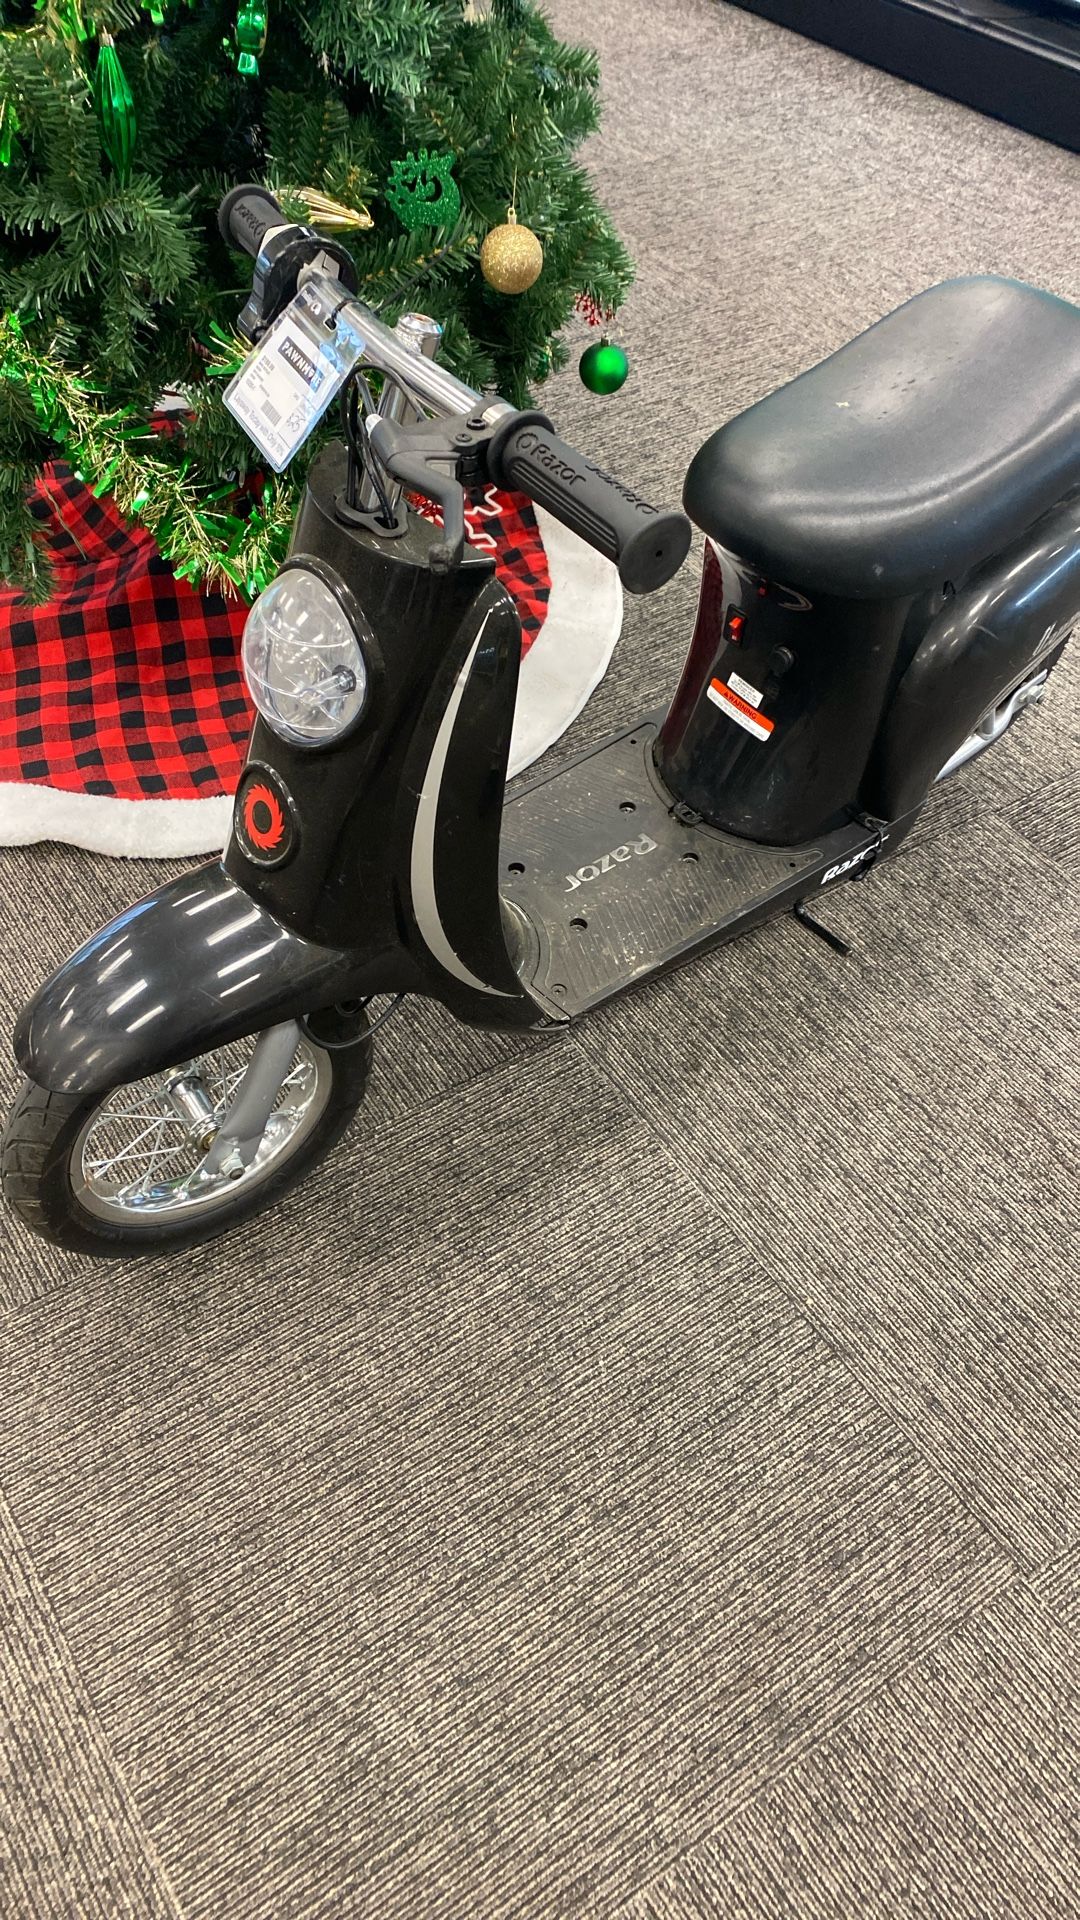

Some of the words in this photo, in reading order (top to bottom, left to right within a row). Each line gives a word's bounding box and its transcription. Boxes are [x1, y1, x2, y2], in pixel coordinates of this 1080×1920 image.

[530, 443, 587, 486] Razor
[728, 694, 758, 720] WARNING
[563, 832, 659, 893] Razor
